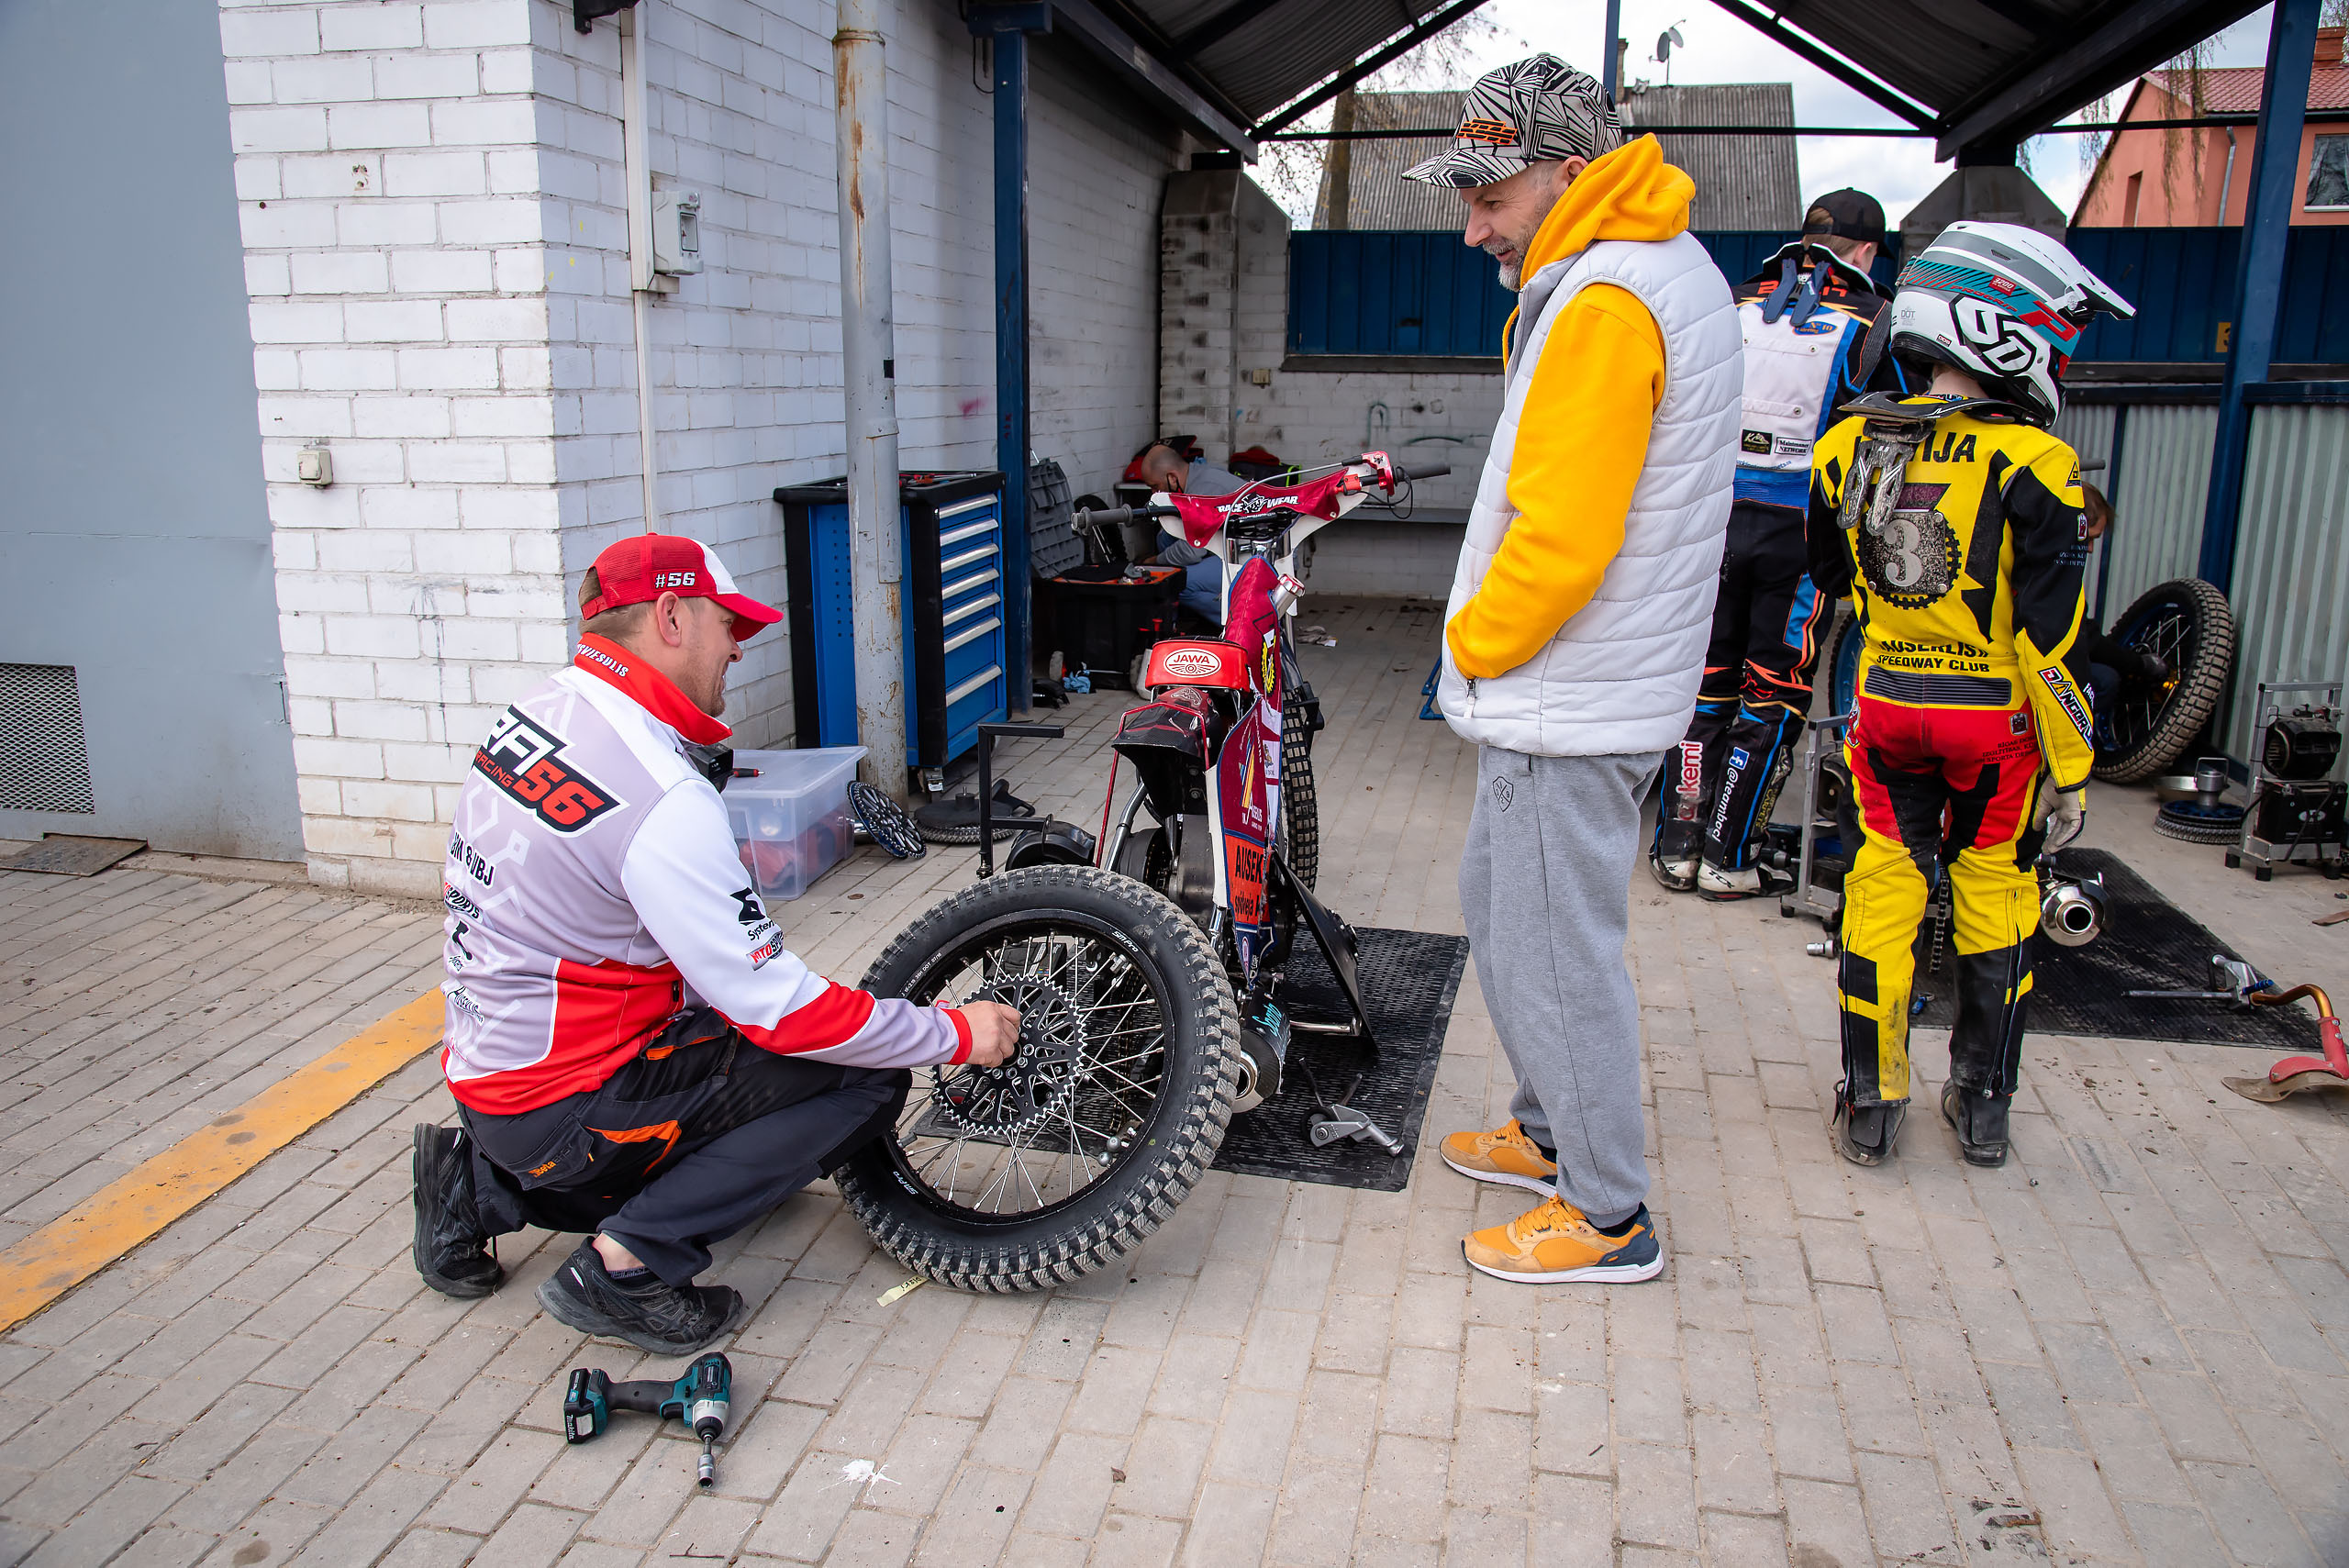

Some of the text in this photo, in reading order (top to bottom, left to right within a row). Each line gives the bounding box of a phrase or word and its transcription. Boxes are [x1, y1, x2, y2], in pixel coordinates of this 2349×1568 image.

[1993, 277, 2014, 290] 3200
[1950, 276, 2018, 313] PROGRIP
[1266, 495, 1299, 509] WEAR
[654, 572, 696, 589] #56
[1174, 654, 1210, 664] JAWA
[1876, 654, 1990, 673] SPEEDWAY CLUB
[474, 750, 515, 788] RACING
[512, 758, 606, 826] 56
